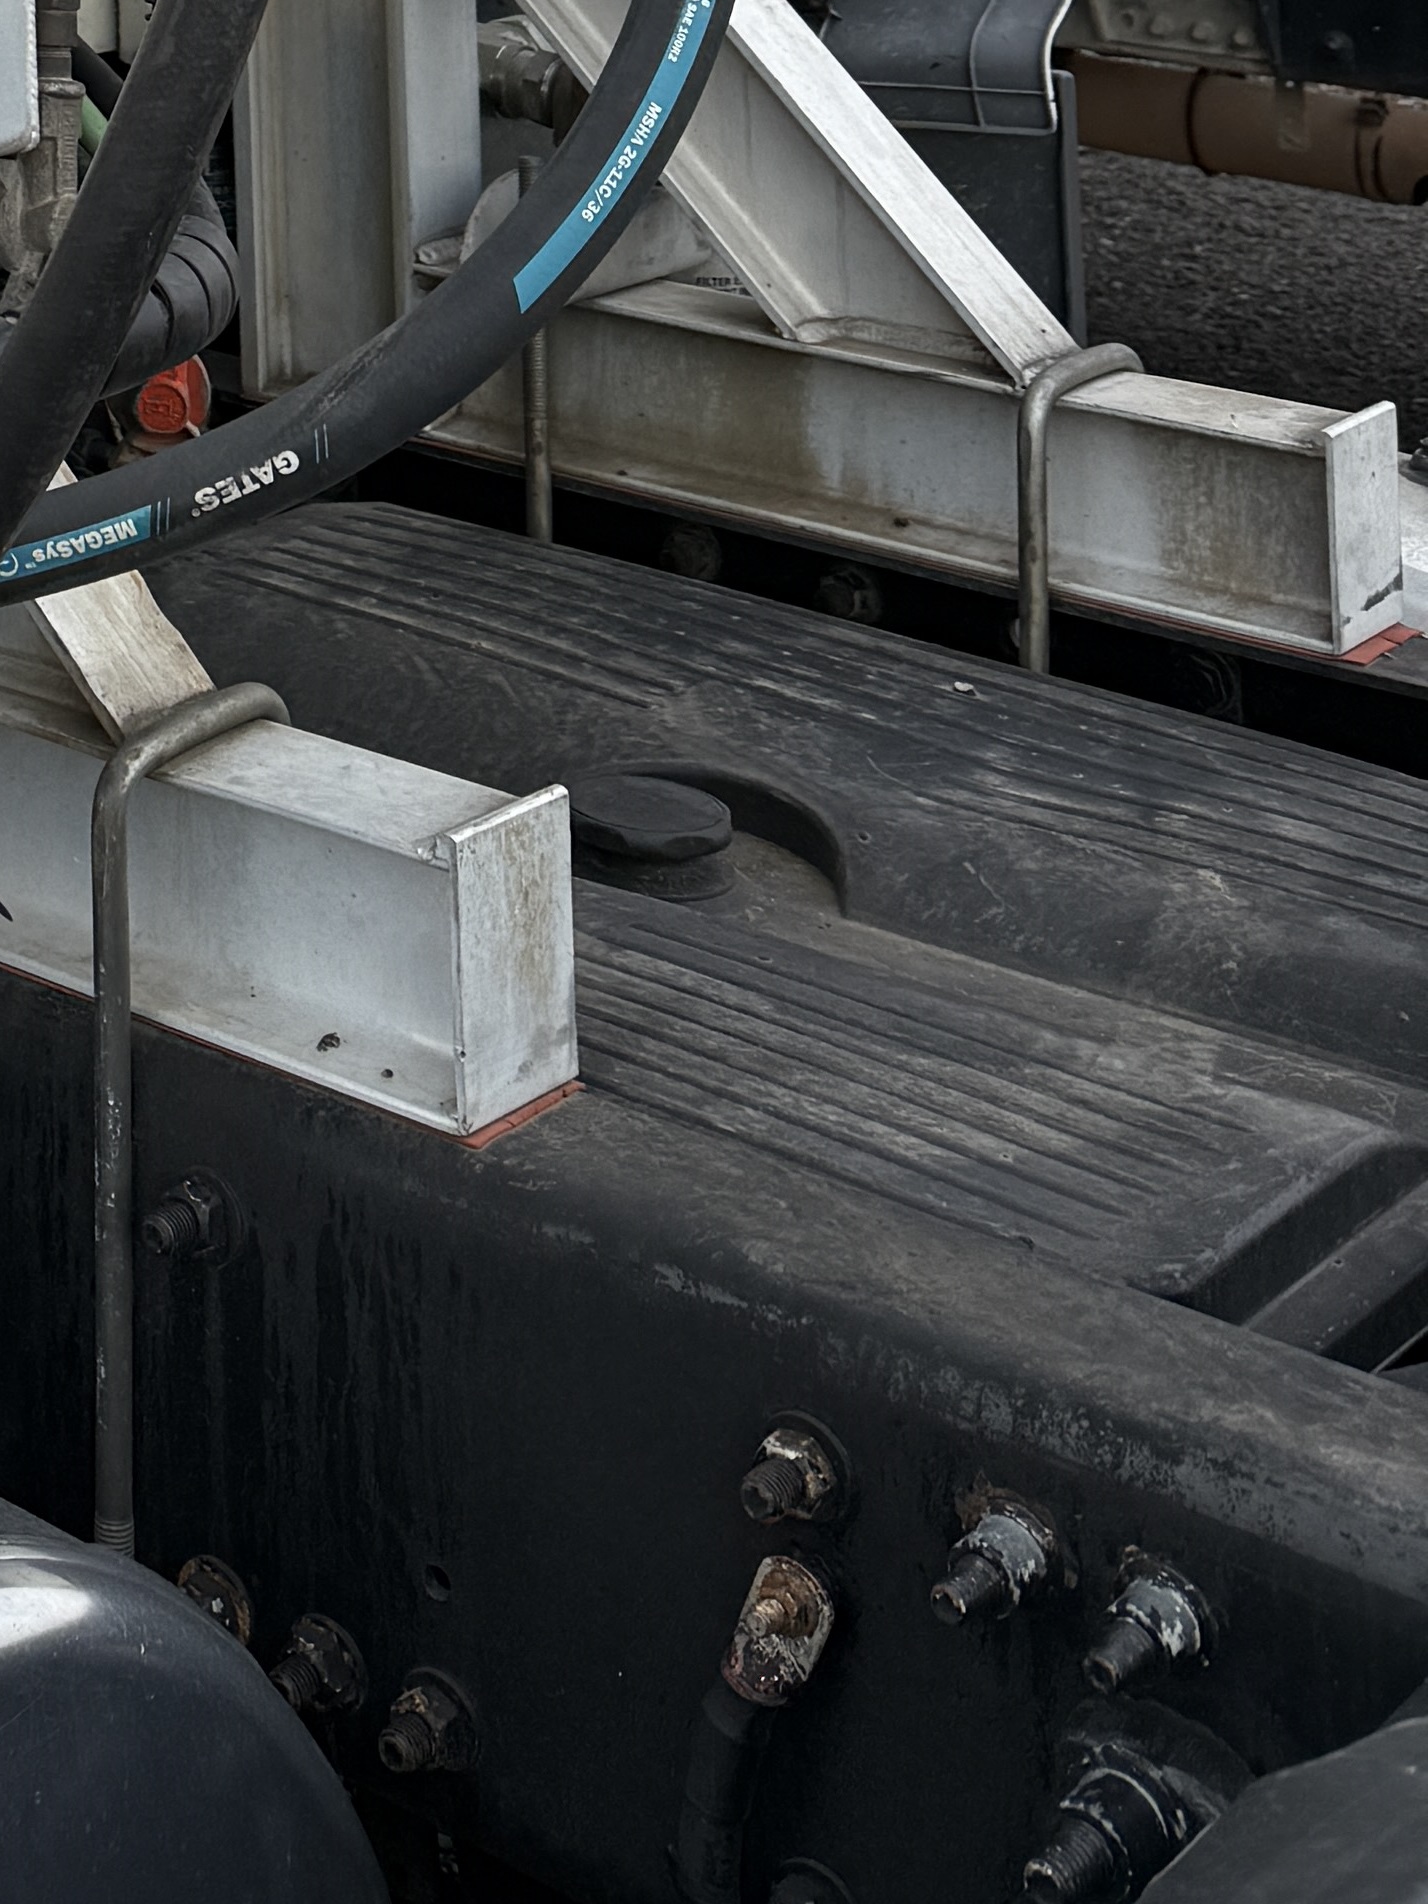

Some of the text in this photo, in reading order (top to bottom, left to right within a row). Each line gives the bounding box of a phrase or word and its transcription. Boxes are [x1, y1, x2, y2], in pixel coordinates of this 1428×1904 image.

[683, 2, 698, 26] SAE
[581, 102, 663, 222] MSHA 2G-11C/36
